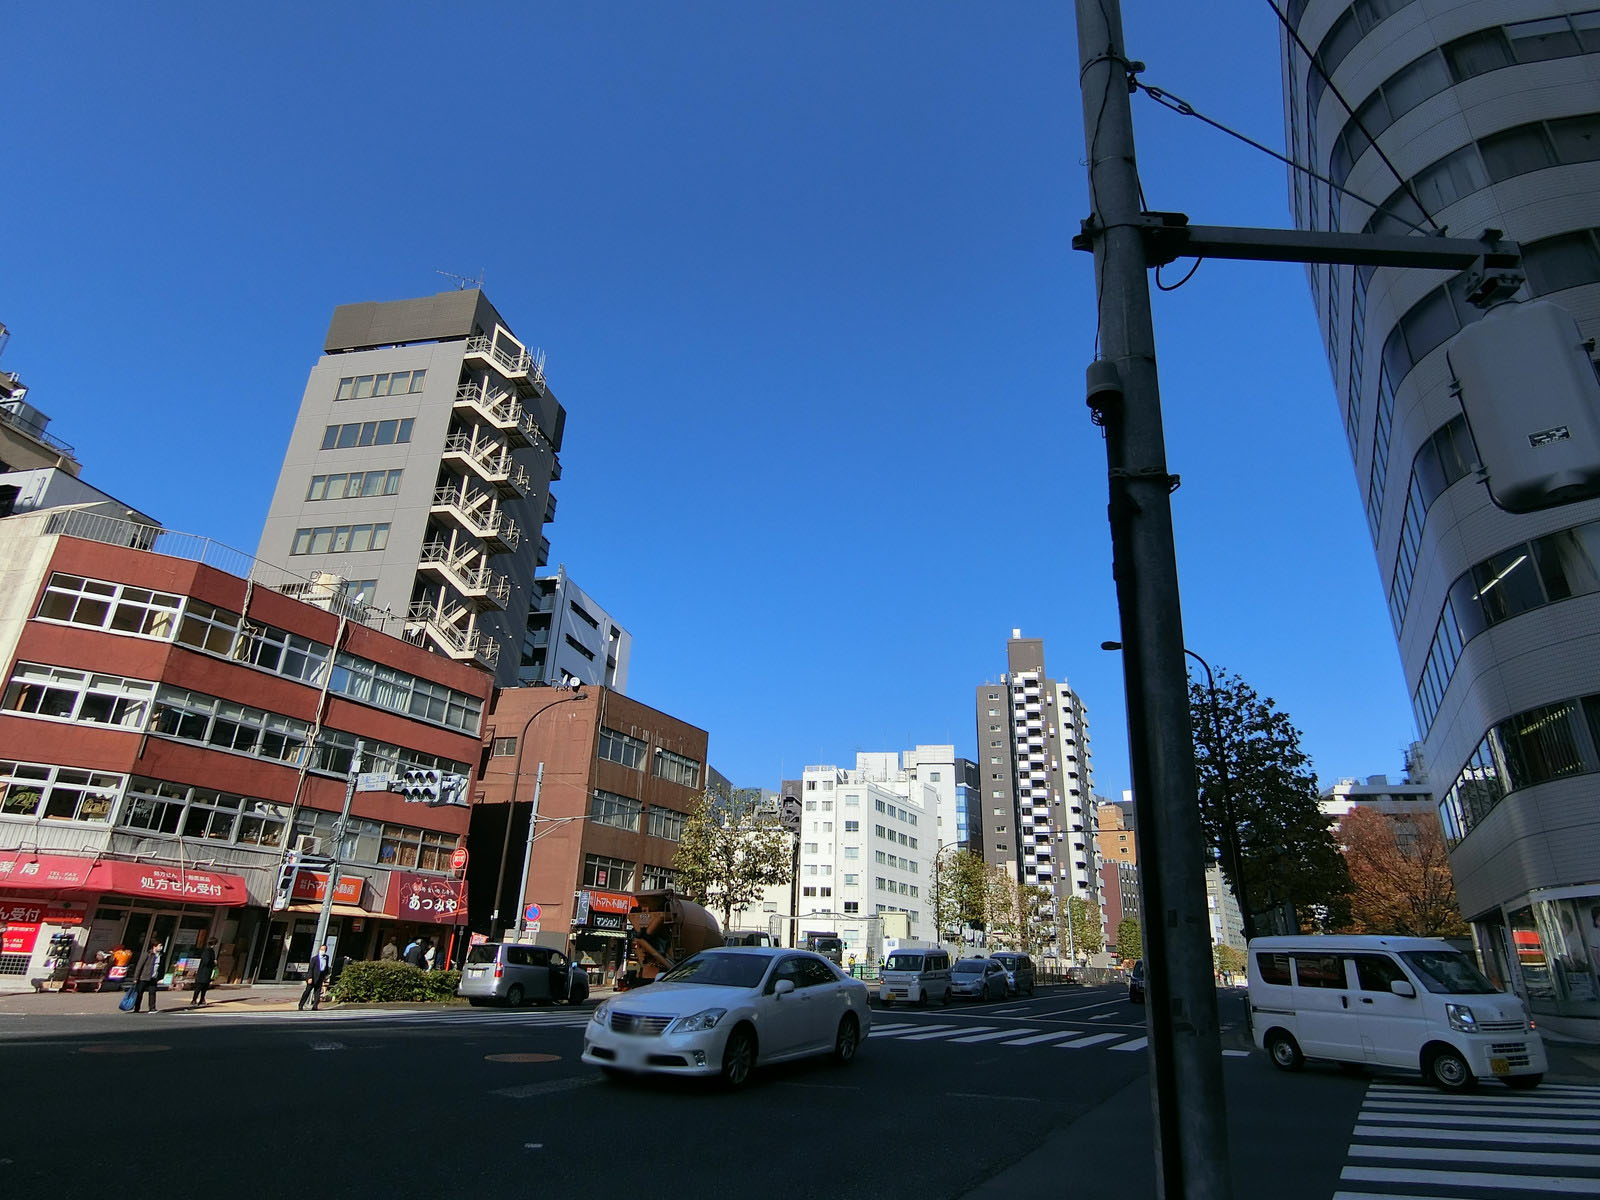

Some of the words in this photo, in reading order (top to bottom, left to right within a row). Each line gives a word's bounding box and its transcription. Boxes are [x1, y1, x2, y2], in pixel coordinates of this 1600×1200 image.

[140, 876, 222, 896] 処方せん受付
[408, 893, 458, 913] あつみや
[596, 916, 618, 927] マンション
